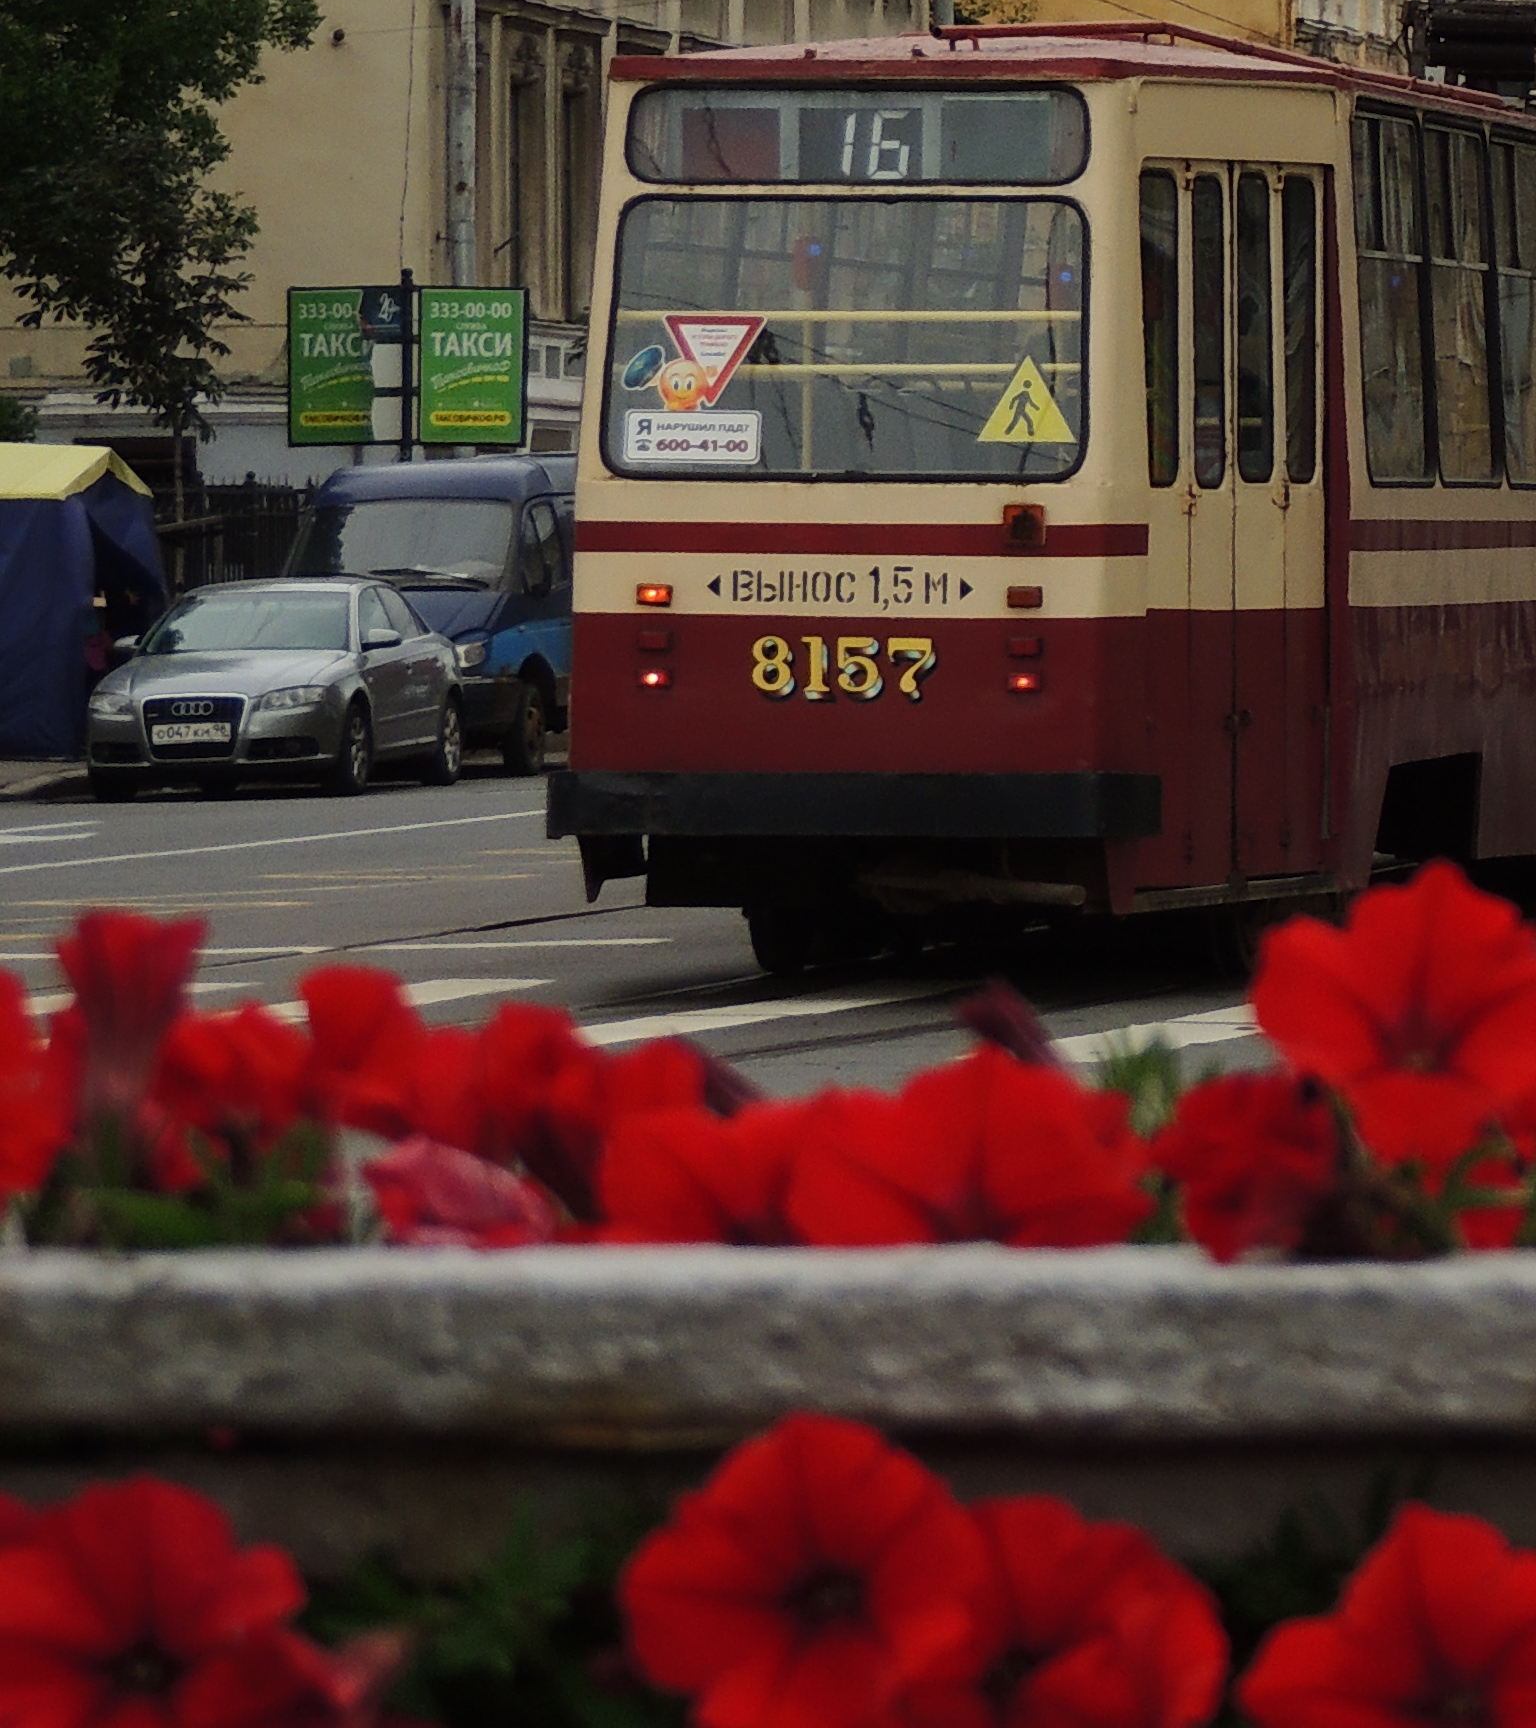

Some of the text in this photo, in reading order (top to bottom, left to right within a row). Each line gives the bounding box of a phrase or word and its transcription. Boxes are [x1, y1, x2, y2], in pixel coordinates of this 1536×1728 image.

[842, 110, 911, 180] 16
[430, 302, 512, 320] 333-00-00
[431, 333, 512, 357] ТАКСИ
[635, 418, 750, 436] Я НАРУШИЛ ПДД?
[656, 438, 749, 453] 600-41-00
[731, 565, 949, 611] ВЫНОС 1,5 М
[751, 634, 938, 703] 8157
